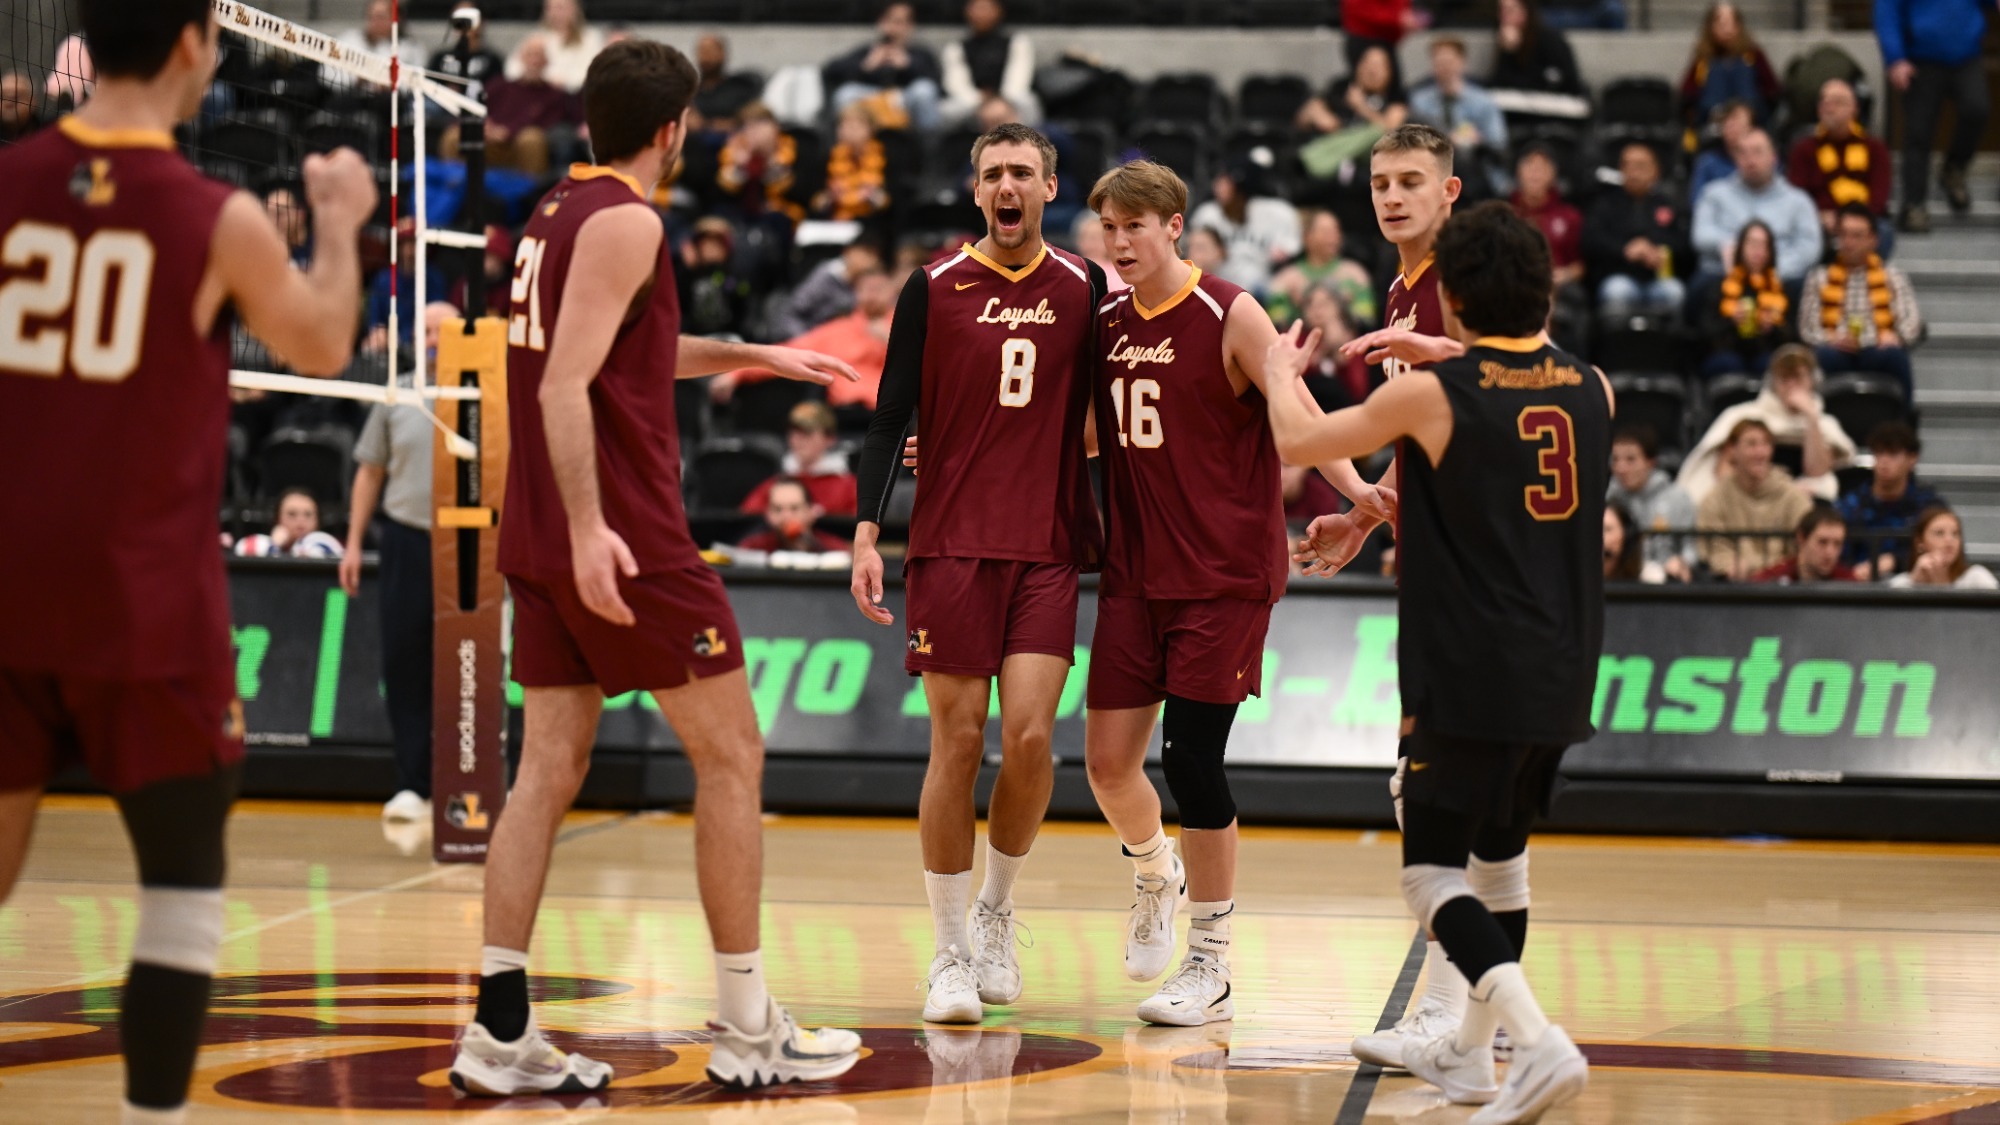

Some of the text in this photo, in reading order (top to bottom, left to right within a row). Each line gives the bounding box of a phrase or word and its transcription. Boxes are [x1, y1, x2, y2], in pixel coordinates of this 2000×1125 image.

[0, 219, 157, 384] 20
[508, 234, 547, 351] 21
[976, 297, 1056, 330] Loyola
[999, 337, 1036, 407] 8
[1107, 334, 1175, 369] Loyola
[1110, 377, 1164, 449] 16
[1517, 405, 1579, 521] 3
[457, 639, 477, 773] sports imports
